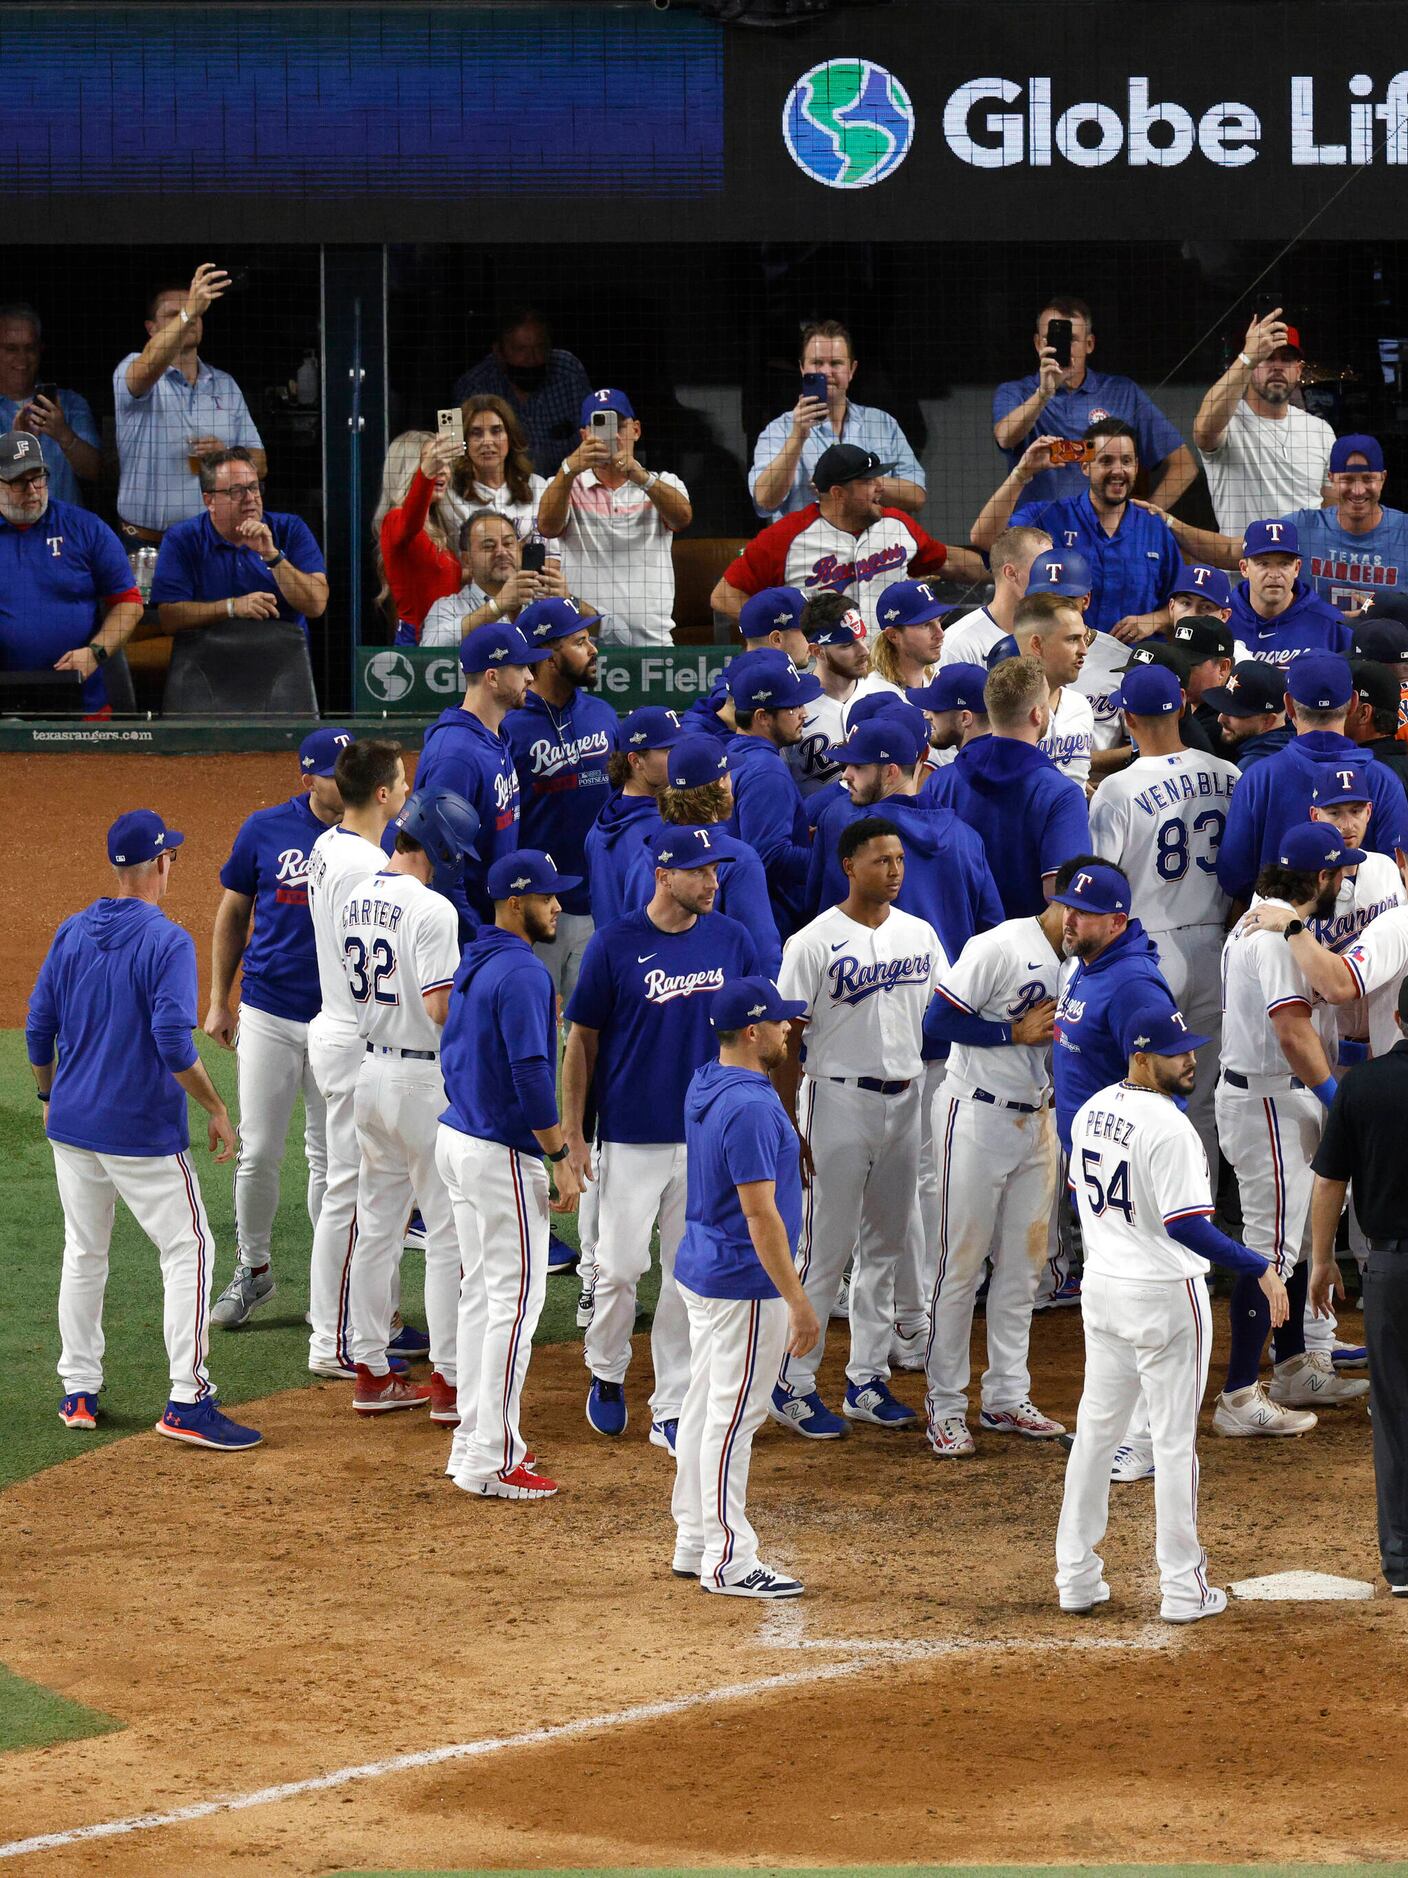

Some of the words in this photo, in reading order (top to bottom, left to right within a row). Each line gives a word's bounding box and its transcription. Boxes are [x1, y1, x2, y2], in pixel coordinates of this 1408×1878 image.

[942, 76, 1261, 168] Globe
[594, 389, 610, 402] T
[1064, 530, 1078, 546] T
[1265, 523, 1284, 542] T
[46, 536, 64, 557] T
[1328, 549, 1382, 565] TEXAS
[805, 543, 907, 594] Rangers
[1045, 563, 1062, 582] T
[1193, 567, 1211, 585] T
[1311, 556, 1398, 586] RANGERS
[916, 583, 935, 601] T
[665, 710, 682, 728] T
[32, 729, 153, 744] texasrangers.com
[529, 731, 609, 777] Rangers
[579, 777, 609, 787] POSTSEAS
[1336, 770, 1354, 790] T
[1134, 772, 1237, 817] VENABLE
[693, 829, 711, 848] T
[1156, 809, 1226, 883] 83
[1073, 872, 1092, 894] T
[342, 899, 403, 934] CARTER
[344, 936, 400, 1006] 32
[827, 952, 932, 1010] Rangers
[644, 967, 724, 1004] Rangers
[1171, 1011, 1188, 1032] T
[1086, 1110, 1136, 1149] PEREZ
[1081, 1148, 1136, 1227] 54
